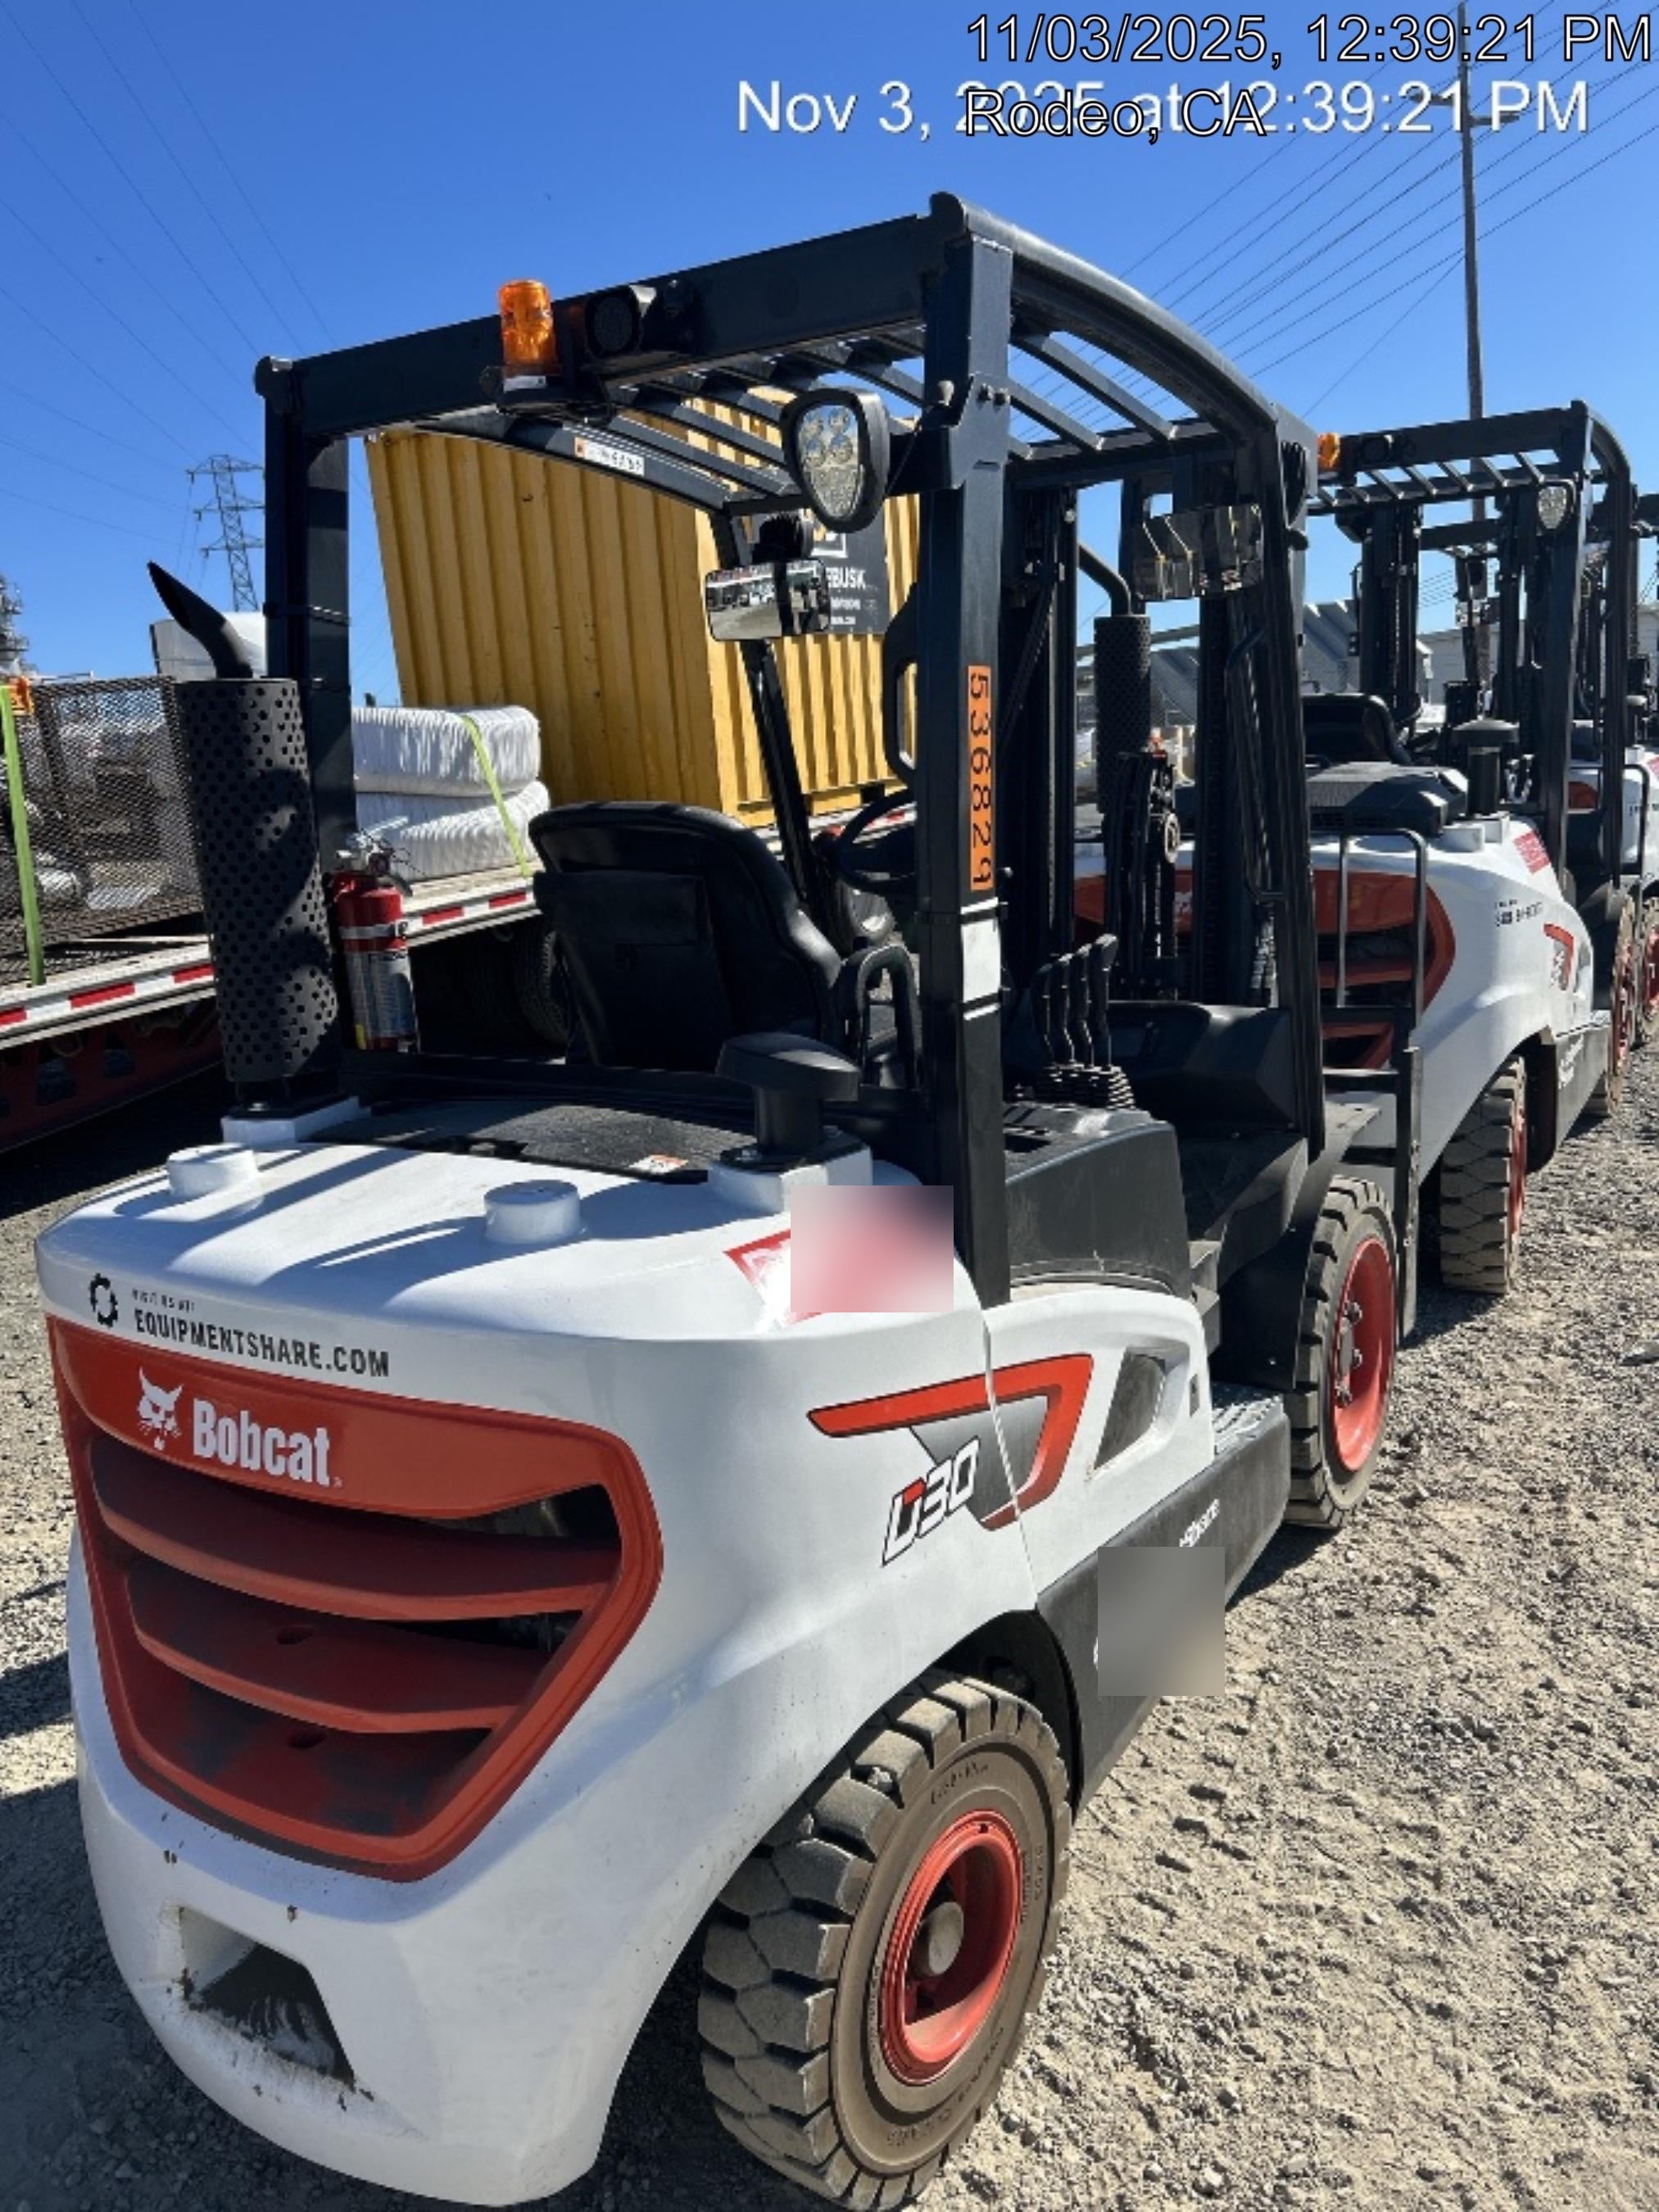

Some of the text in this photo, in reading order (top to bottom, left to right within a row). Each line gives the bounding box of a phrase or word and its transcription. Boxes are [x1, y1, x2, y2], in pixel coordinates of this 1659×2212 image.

[969, 672, 992, 885] 536829
[134, 1308, 390, 1378] EQUIPMENTSHARE.COM
[193, 1398, 330, 1488] Bobcat
[881, 1435, 981, 1567] D30
